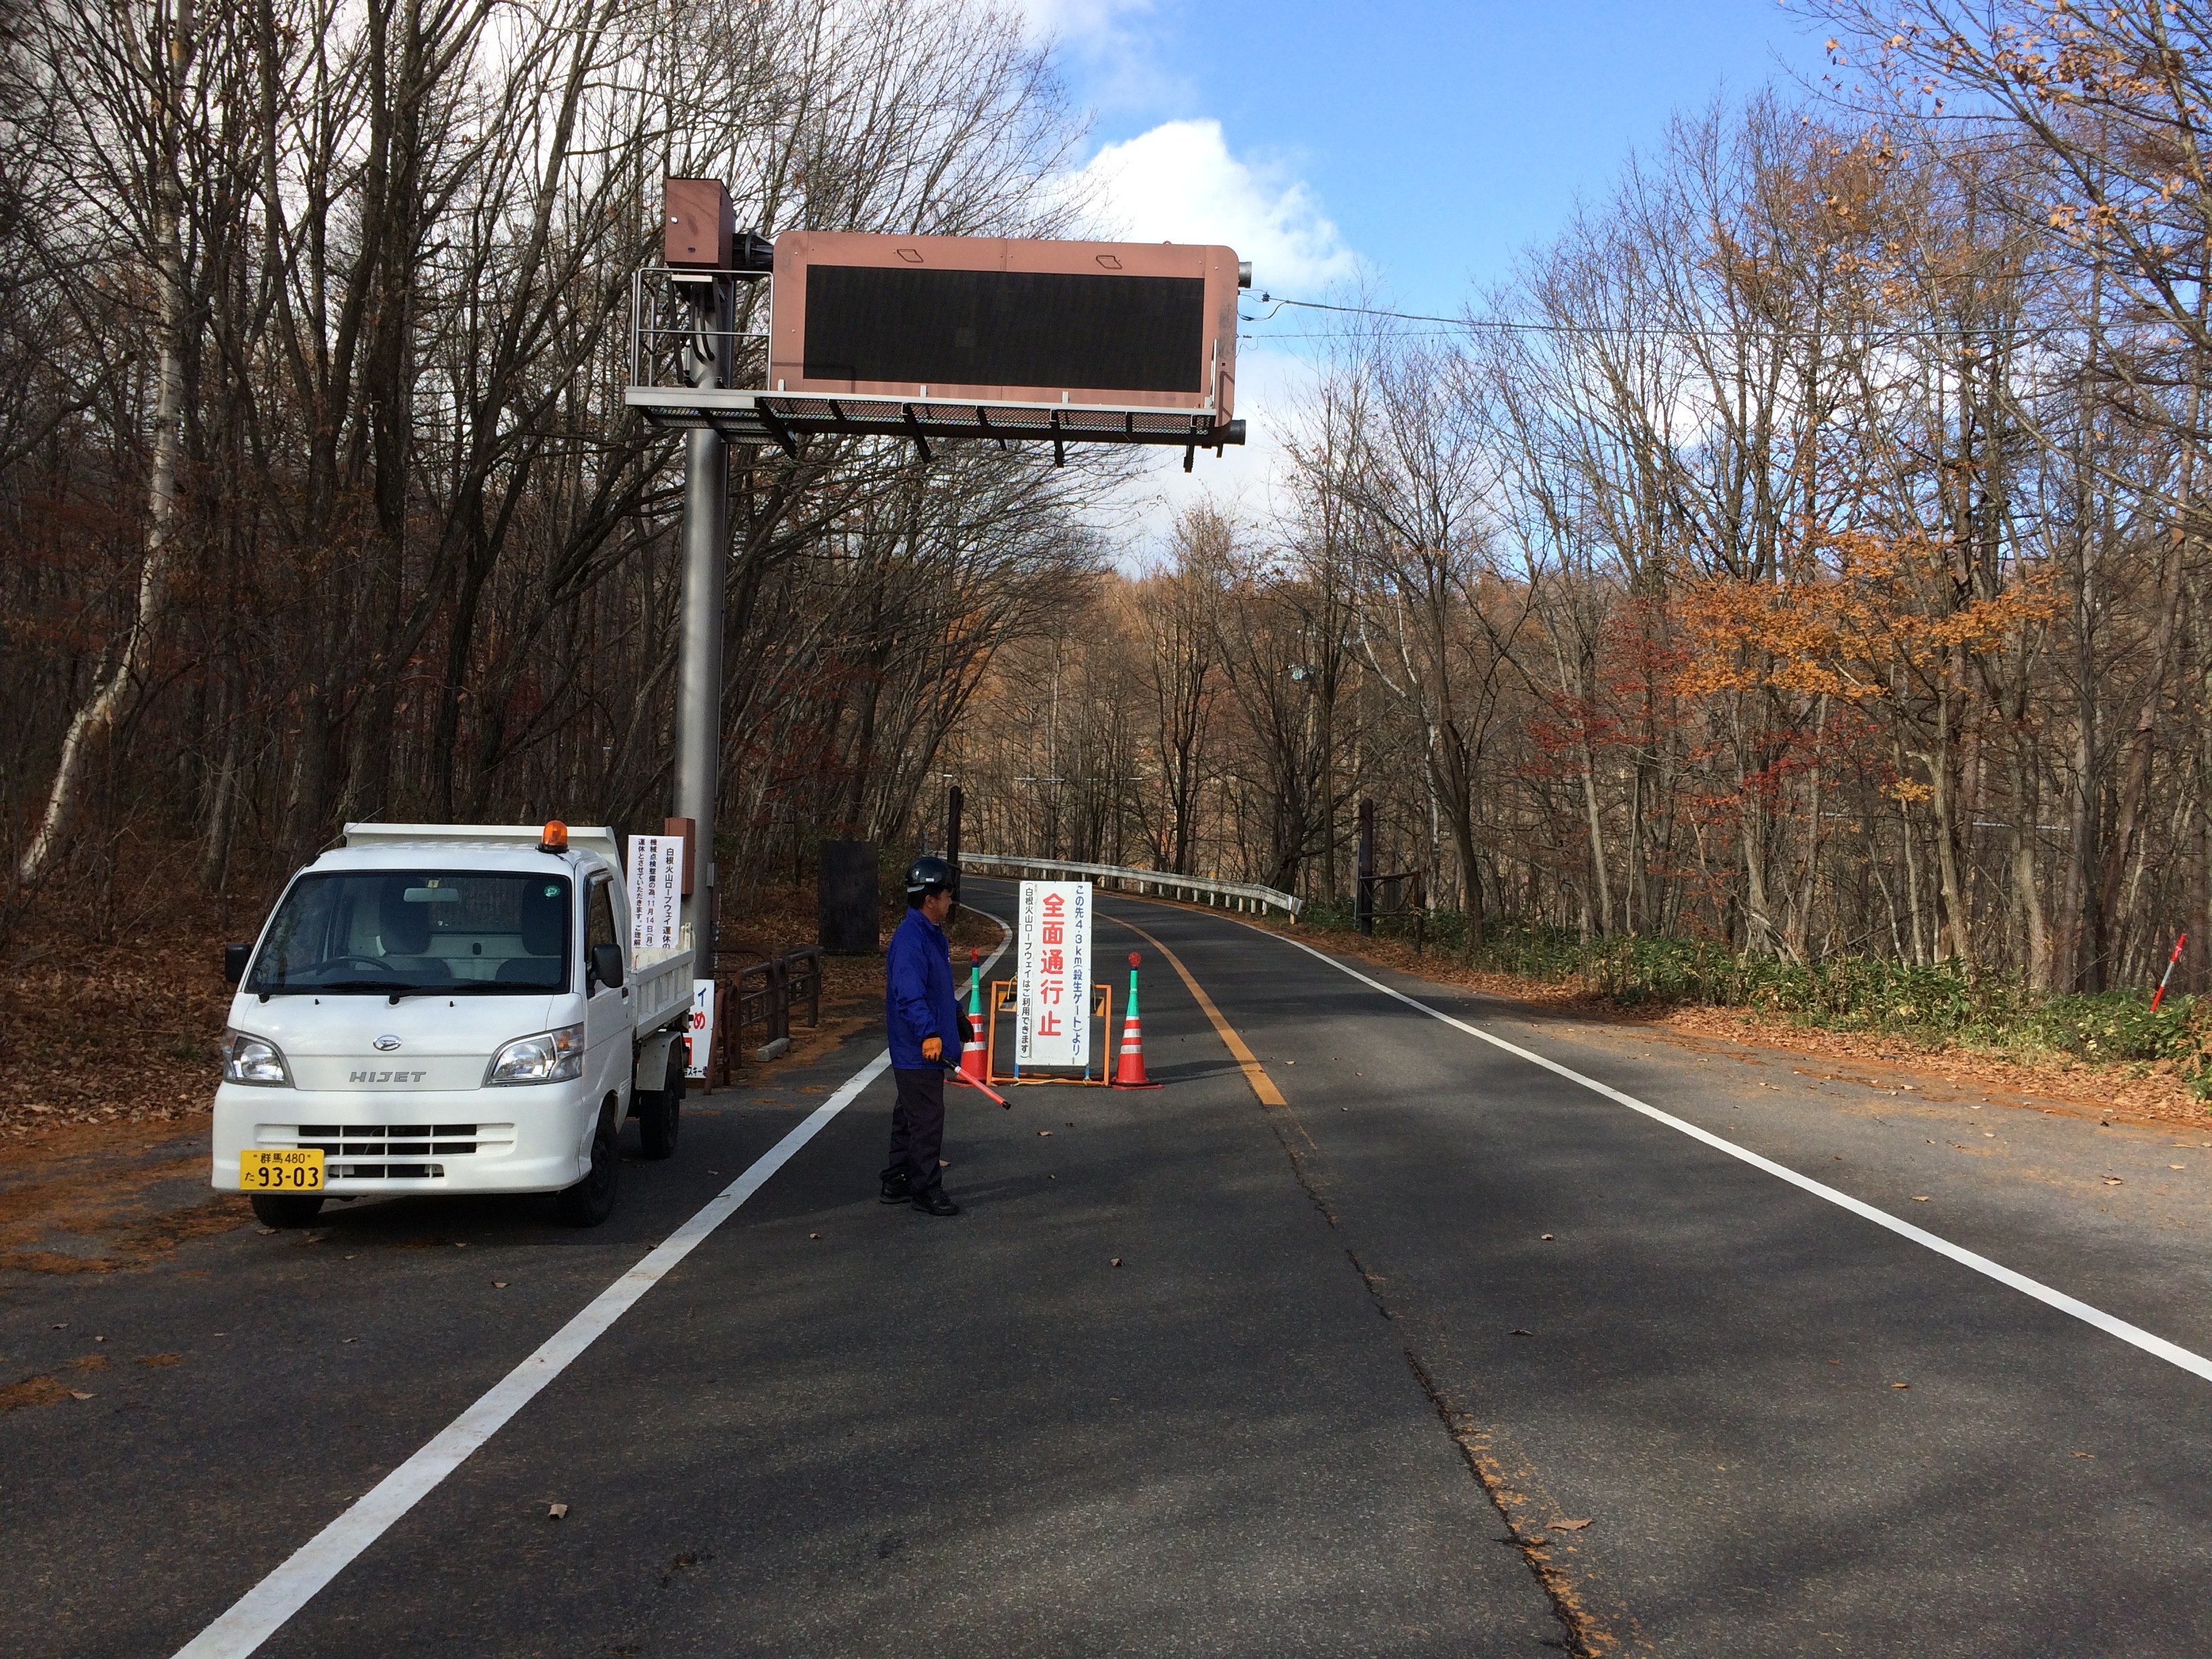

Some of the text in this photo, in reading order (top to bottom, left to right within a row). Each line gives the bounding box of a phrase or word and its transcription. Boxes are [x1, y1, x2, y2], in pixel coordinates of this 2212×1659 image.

[633, 838, 645, 949] 運休とさせていただきます。ご理解
[1038, 893, 1065, 1036] 全面通行止
[349, 1071, 427, 1082] HIJET
[244, 1166, 319, 1187] た 93-03
